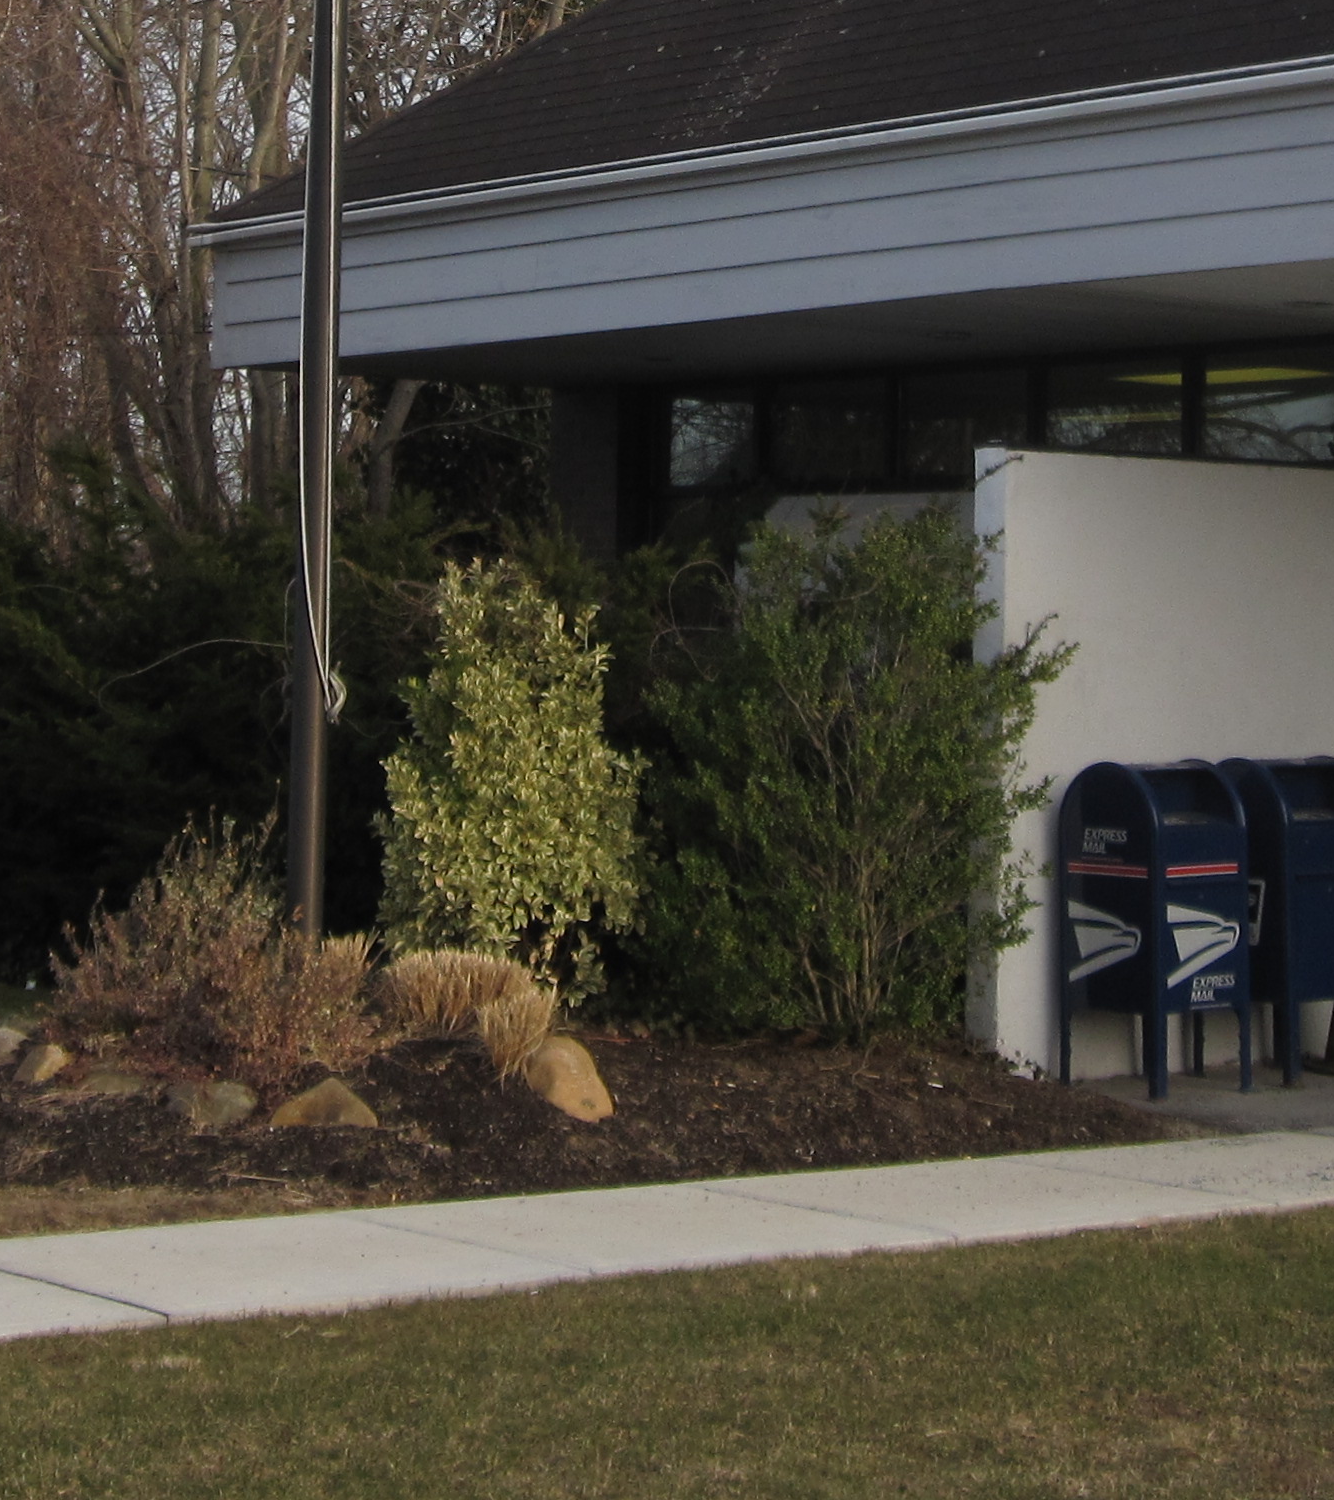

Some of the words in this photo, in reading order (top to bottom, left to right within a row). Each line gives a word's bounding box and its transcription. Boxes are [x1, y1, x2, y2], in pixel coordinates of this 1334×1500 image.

[1084, 828, 1127, 842] EXPRESS
[1082, 842, 1107, 854] MAIL
[1192, 975, 1235, 989] EXPRESS
[1191, 988, 1215, 1002] MAIL
